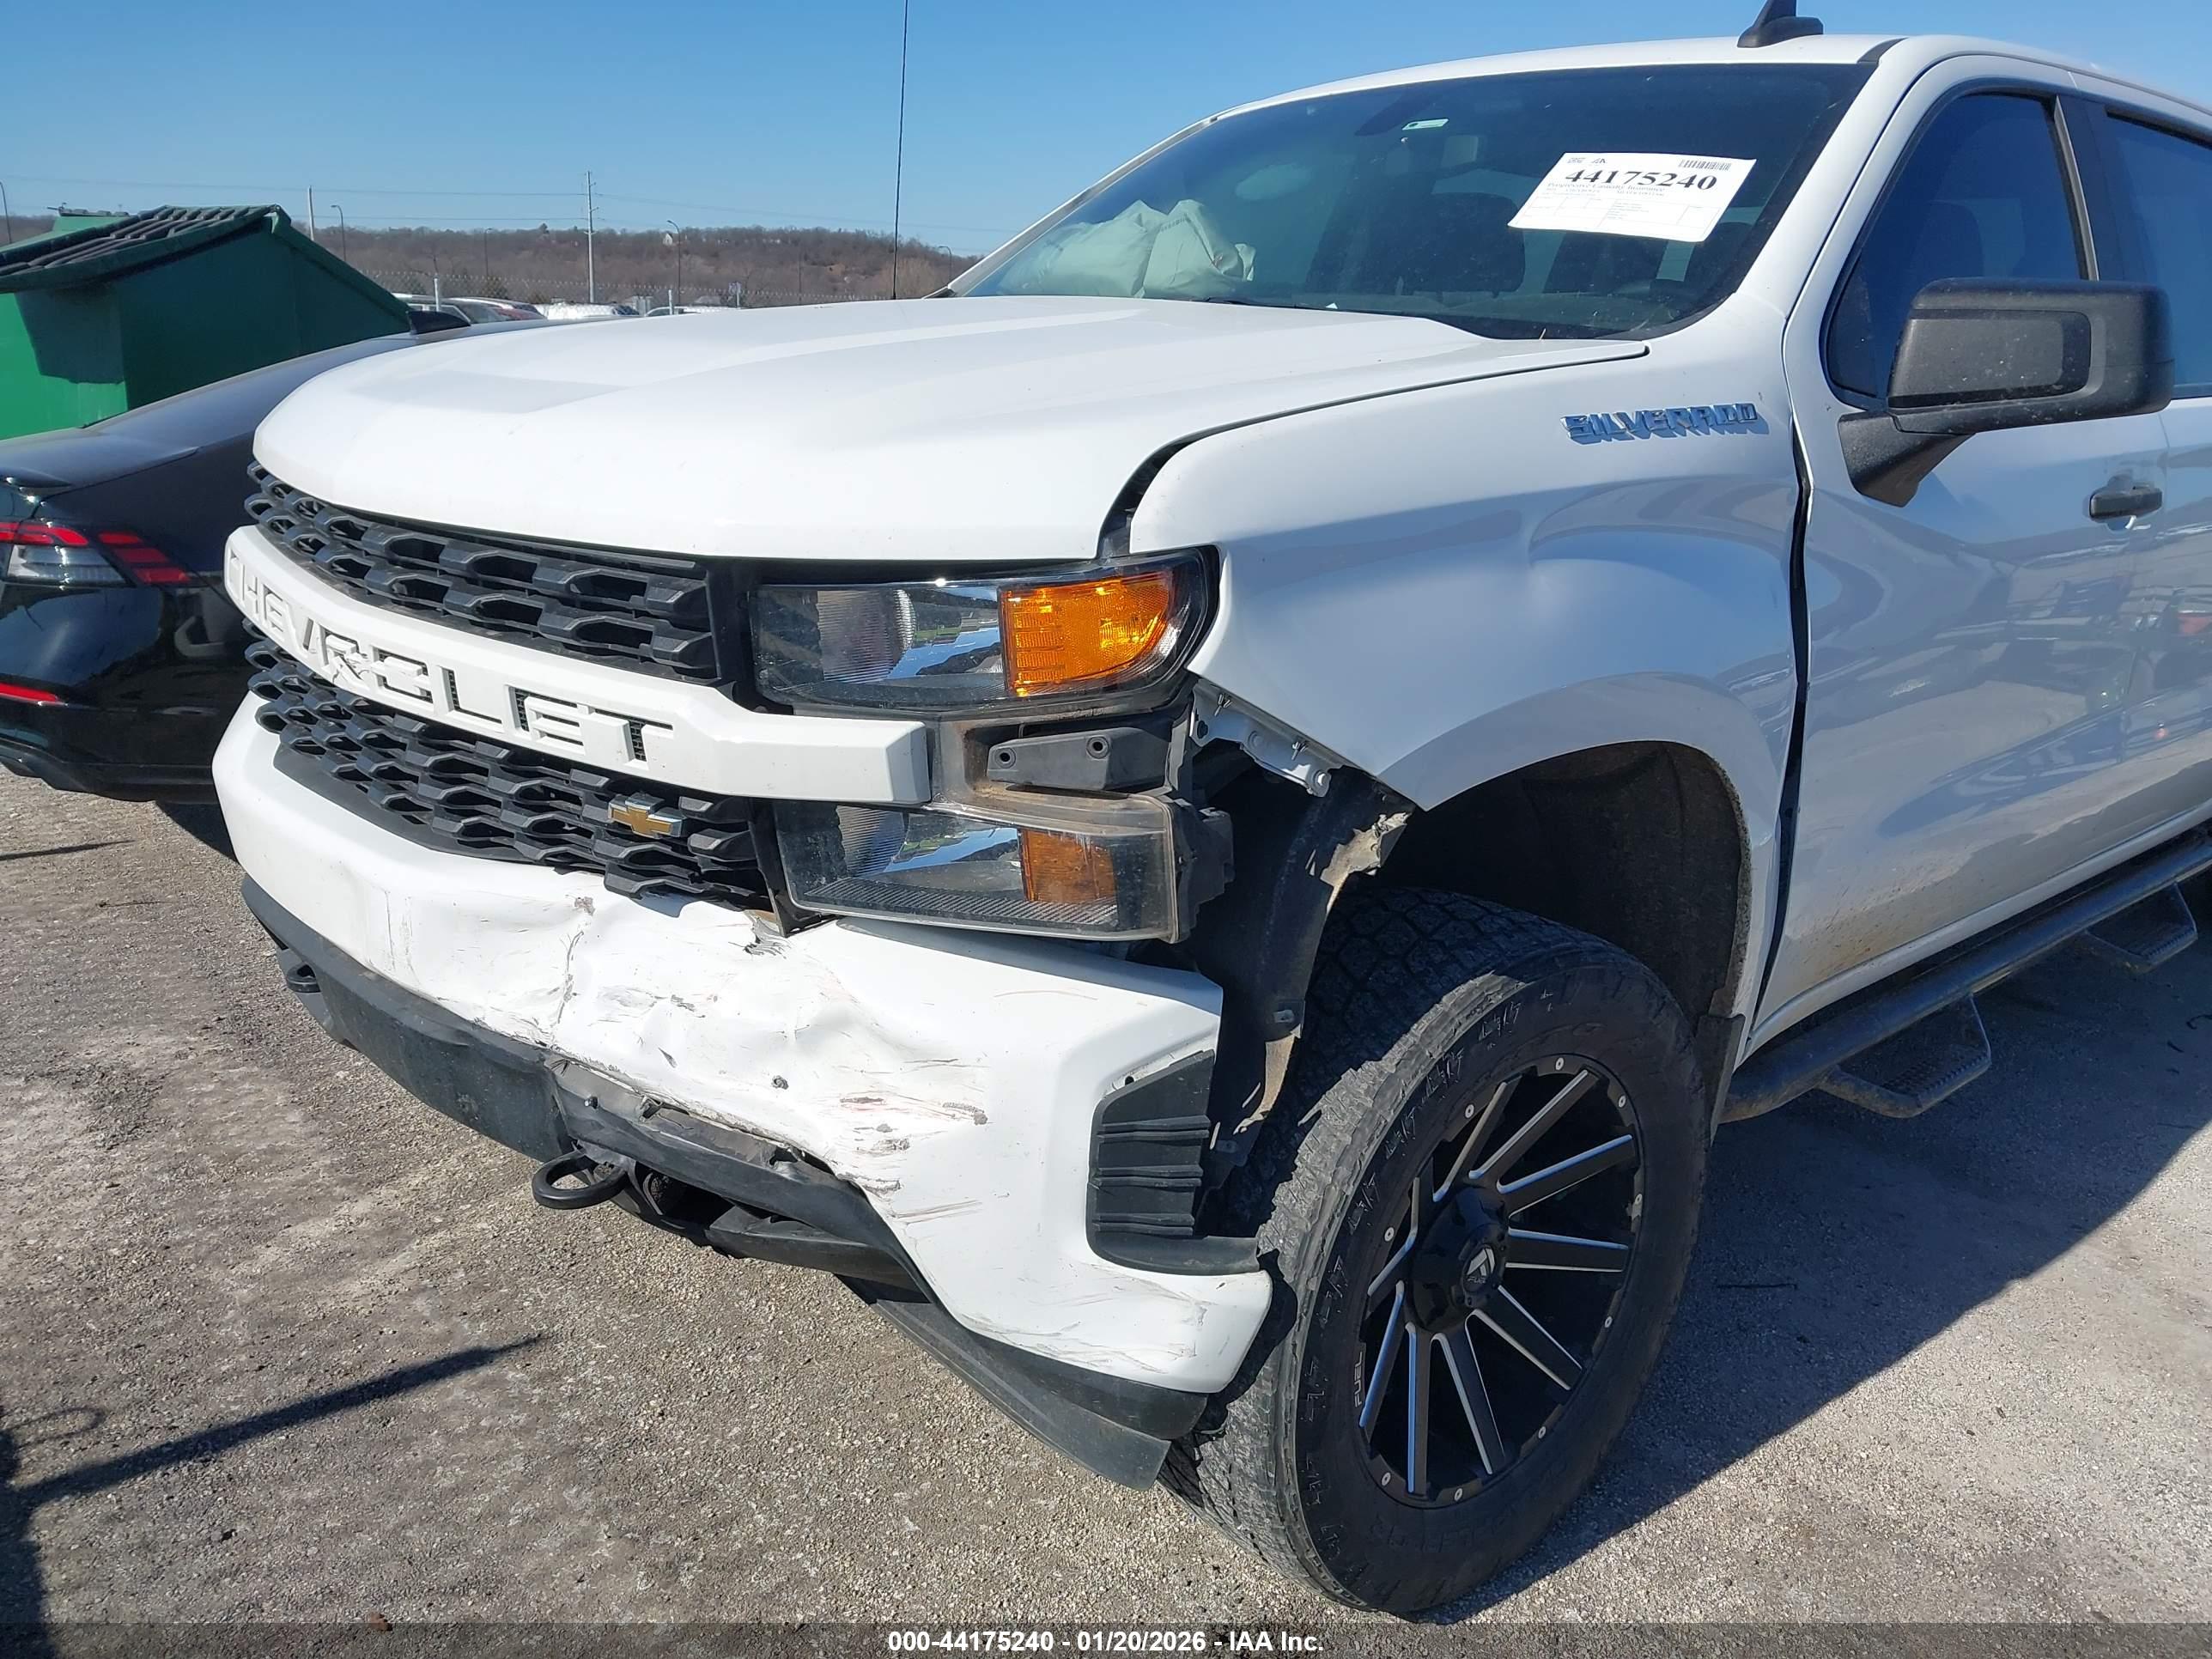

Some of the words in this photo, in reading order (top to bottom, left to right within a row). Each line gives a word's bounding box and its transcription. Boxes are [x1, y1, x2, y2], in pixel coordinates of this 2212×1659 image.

[1565, 168, 1717, 191] 44175240
[1560, 403, 1759, 439] SILVERADO
[228, 547, 674, 763] CHEVROLET
[1353, 1350, 1364, 1408] FUEL
